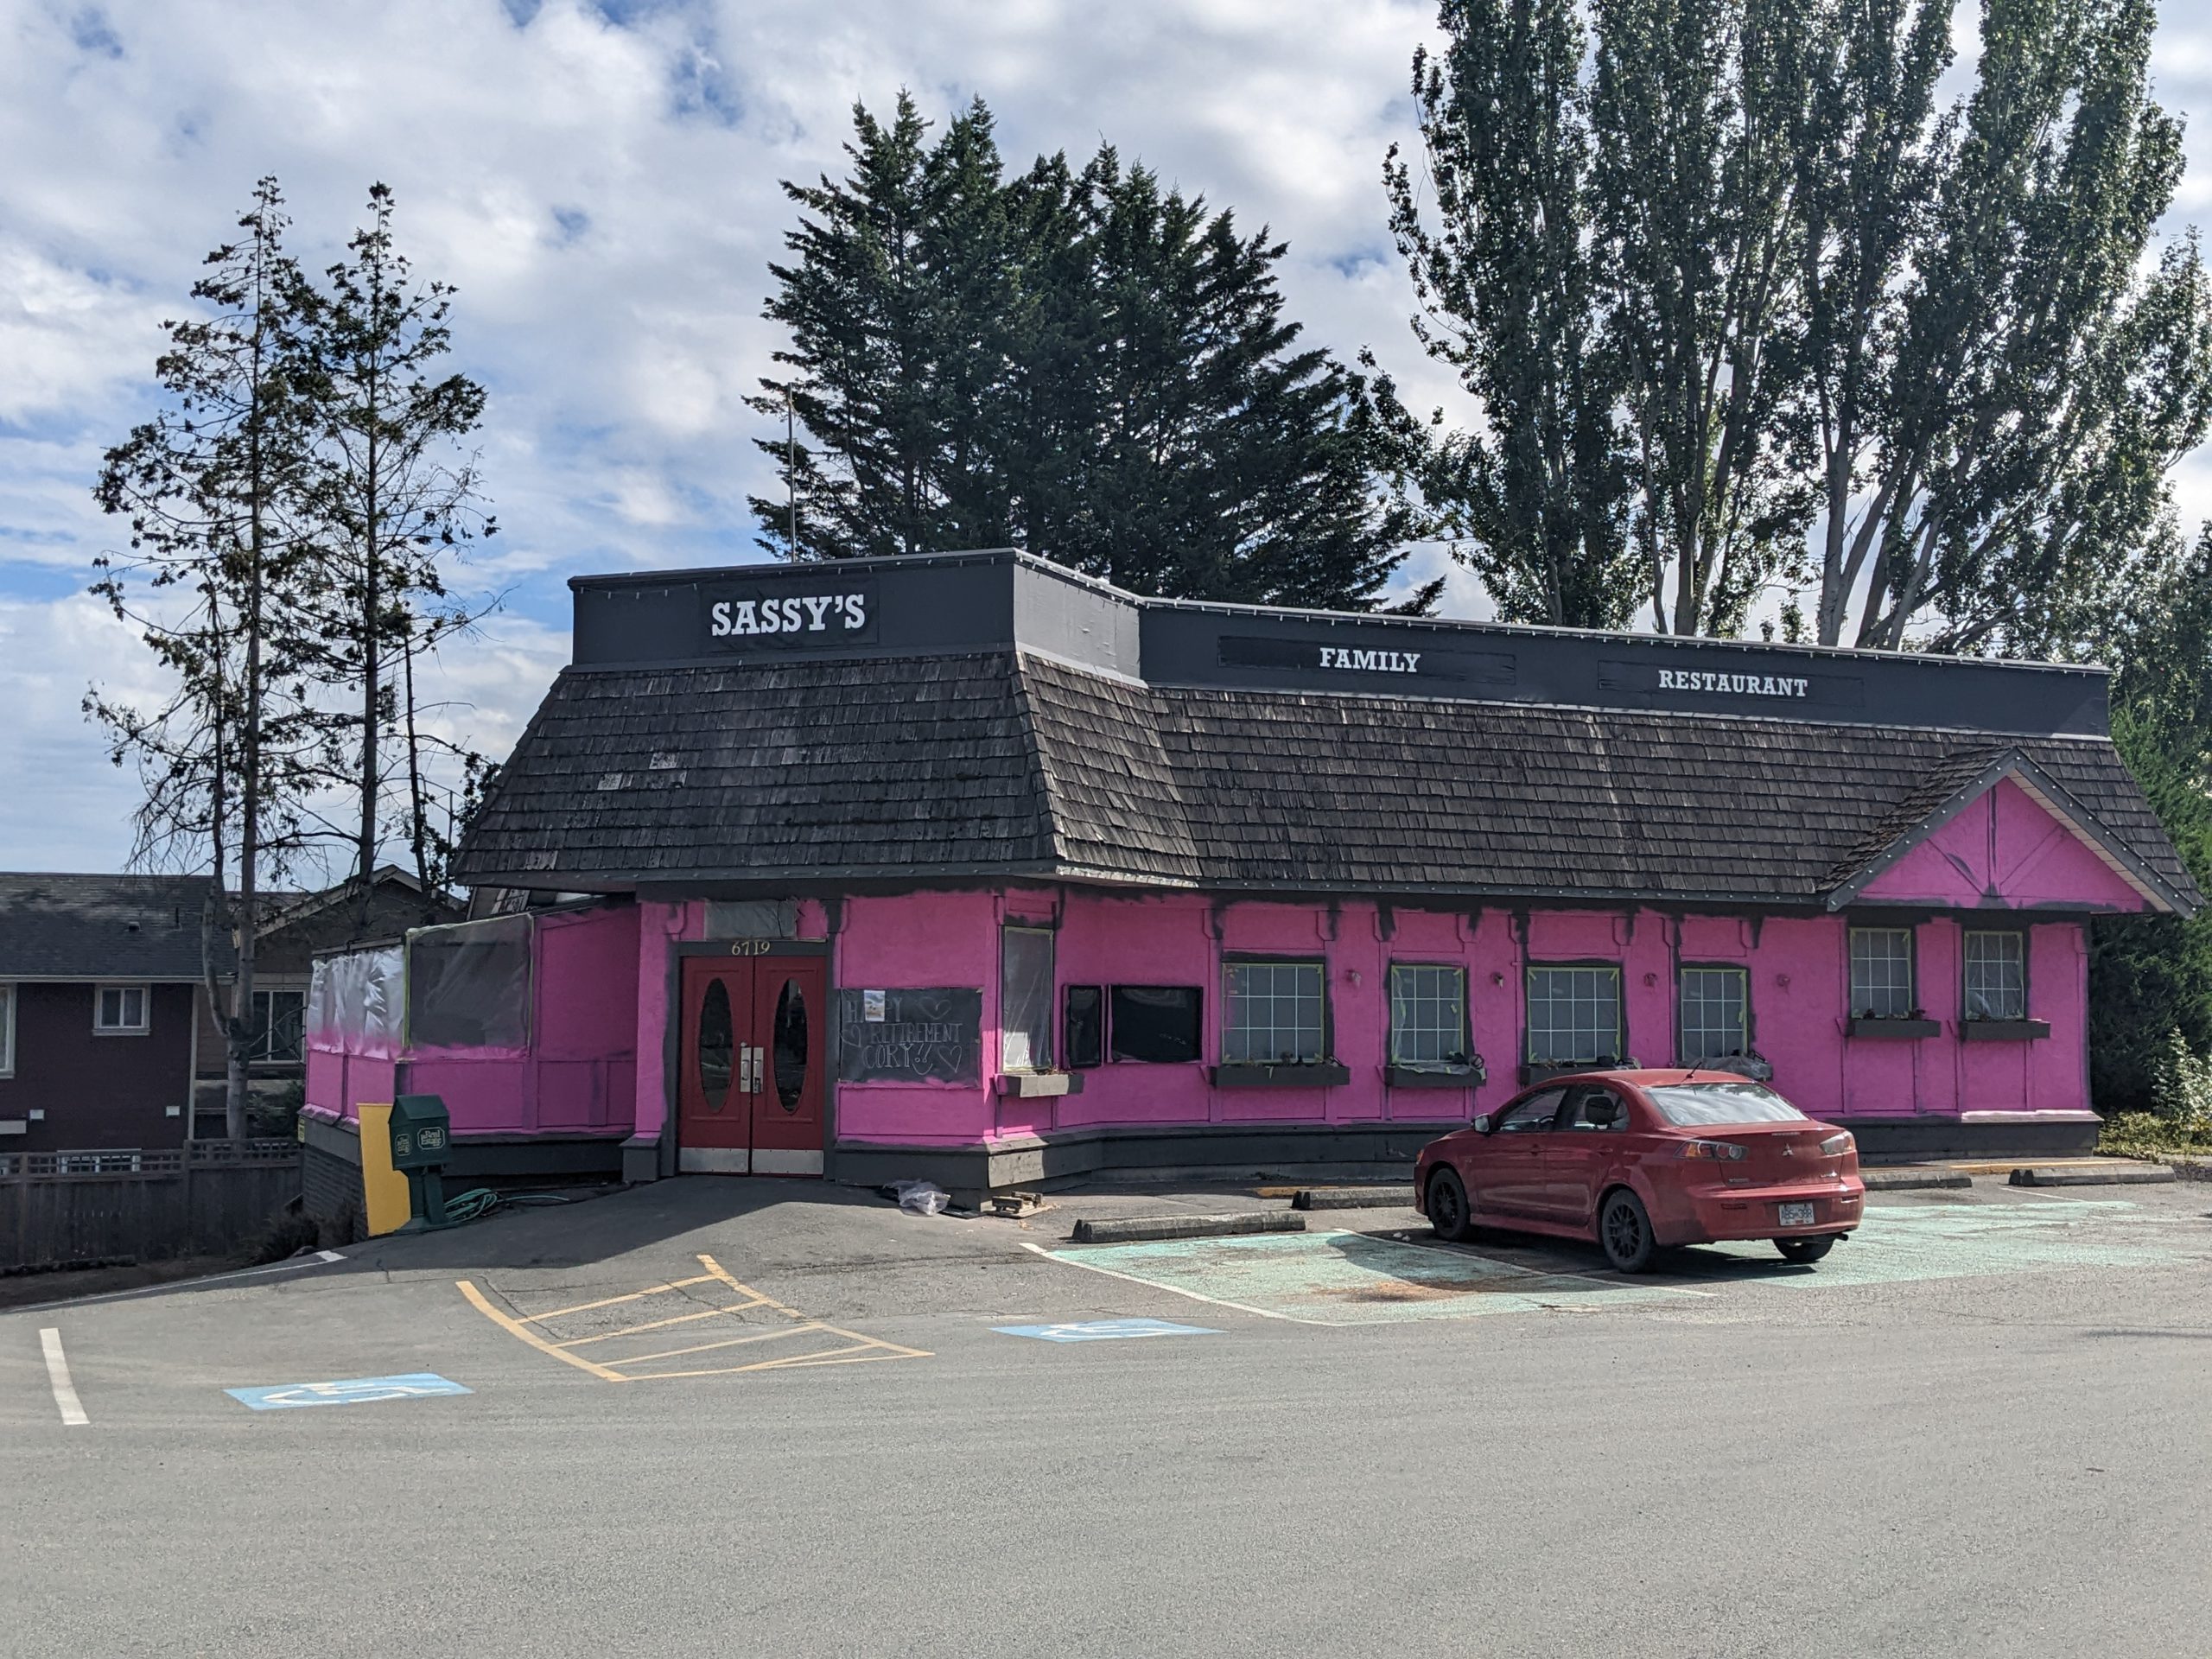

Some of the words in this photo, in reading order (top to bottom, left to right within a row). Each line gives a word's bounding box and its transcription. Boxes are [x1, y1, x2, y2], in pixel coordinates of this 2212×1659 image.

[712, 594, 865, 636] SASSY'S
[1319, 647, 1421, 673] FAMILY
[1658, 670, 1808, 697] RESTAURANT
[731, 940, 771, 956] 6719
[869, 1022, 963, 1044] RETIREMENT
